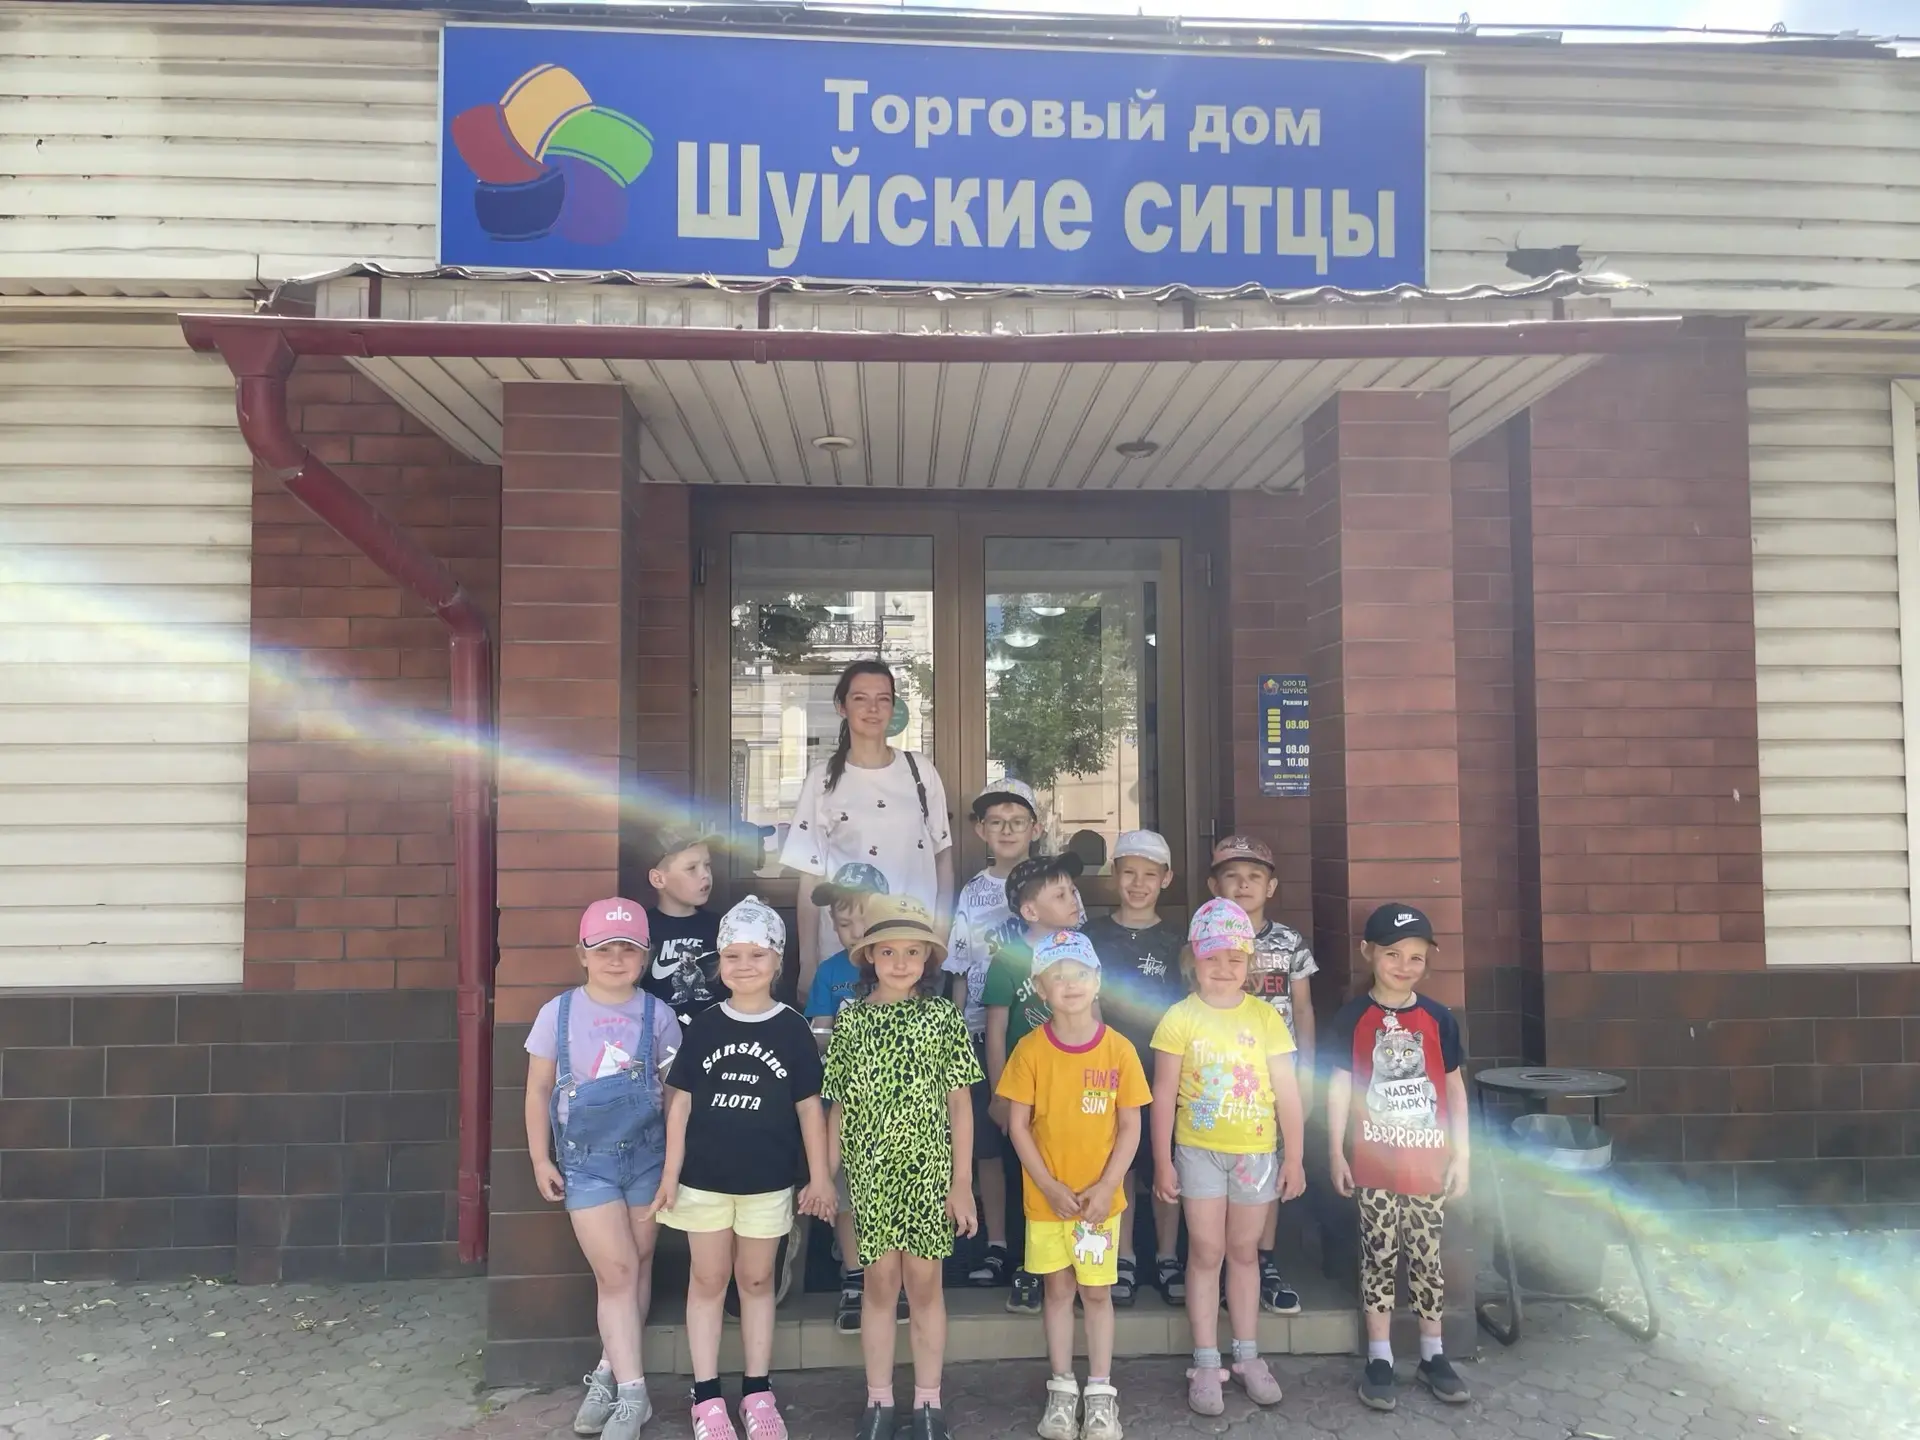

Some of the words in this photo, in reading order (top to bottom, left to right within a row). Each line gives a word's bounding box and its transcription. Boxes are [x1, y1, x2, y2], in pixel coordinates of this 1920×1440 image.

[824, 78, 1165, 149] Торговый
[1188, 104, 1322, 154] дом
[677, 141, 1094, 269] Шуйские
[1124, 181, 1396, 275] ситцы
[1286, 757, 1309, 767] 10.00
[605, 906, 632, 922] alo
[1397, 913, 1413, 921] NIKE
[702, 1041, 788, 1079] Sunshine
[721, 1072, 737, 1081] on
[737, 1073, 760, 1085] my
[1084, 1069, 1108, 1088] FUN
[1384, 1083, 1421, 1098] NADEN
[710, 1093, 762, 1111] FLOTA
[1081, 1096, 1108, 1115] SUN
[1387, 1096, 1428, 1112] SHAPKY
